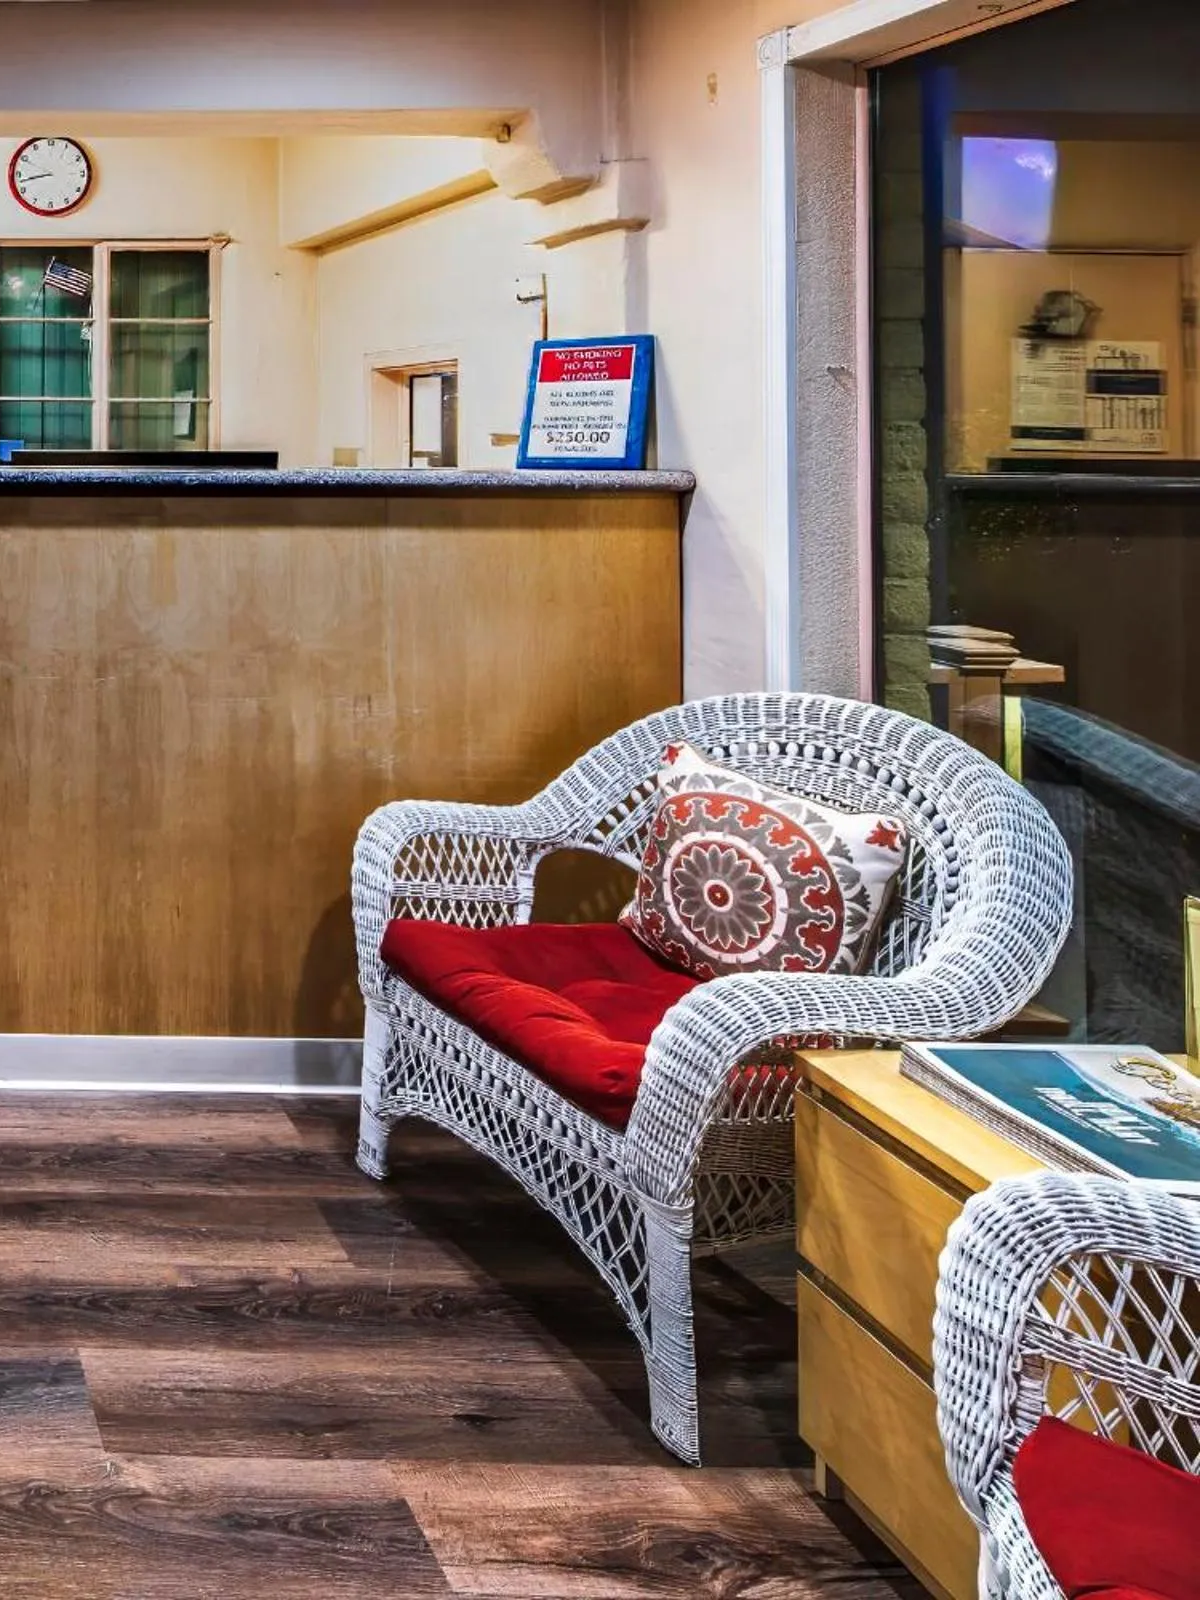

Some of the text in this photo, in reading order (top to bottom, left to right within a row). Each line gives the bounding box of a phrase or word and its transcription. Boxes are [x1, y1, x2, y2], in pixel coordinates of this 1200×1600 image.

[555, 349, 623, 361] NO SMOKING
[563, 361, 608, 370] NO PETS
[560, 372, 609, 381] ALLOWED
[546, 431, 611, 444] $250.00
